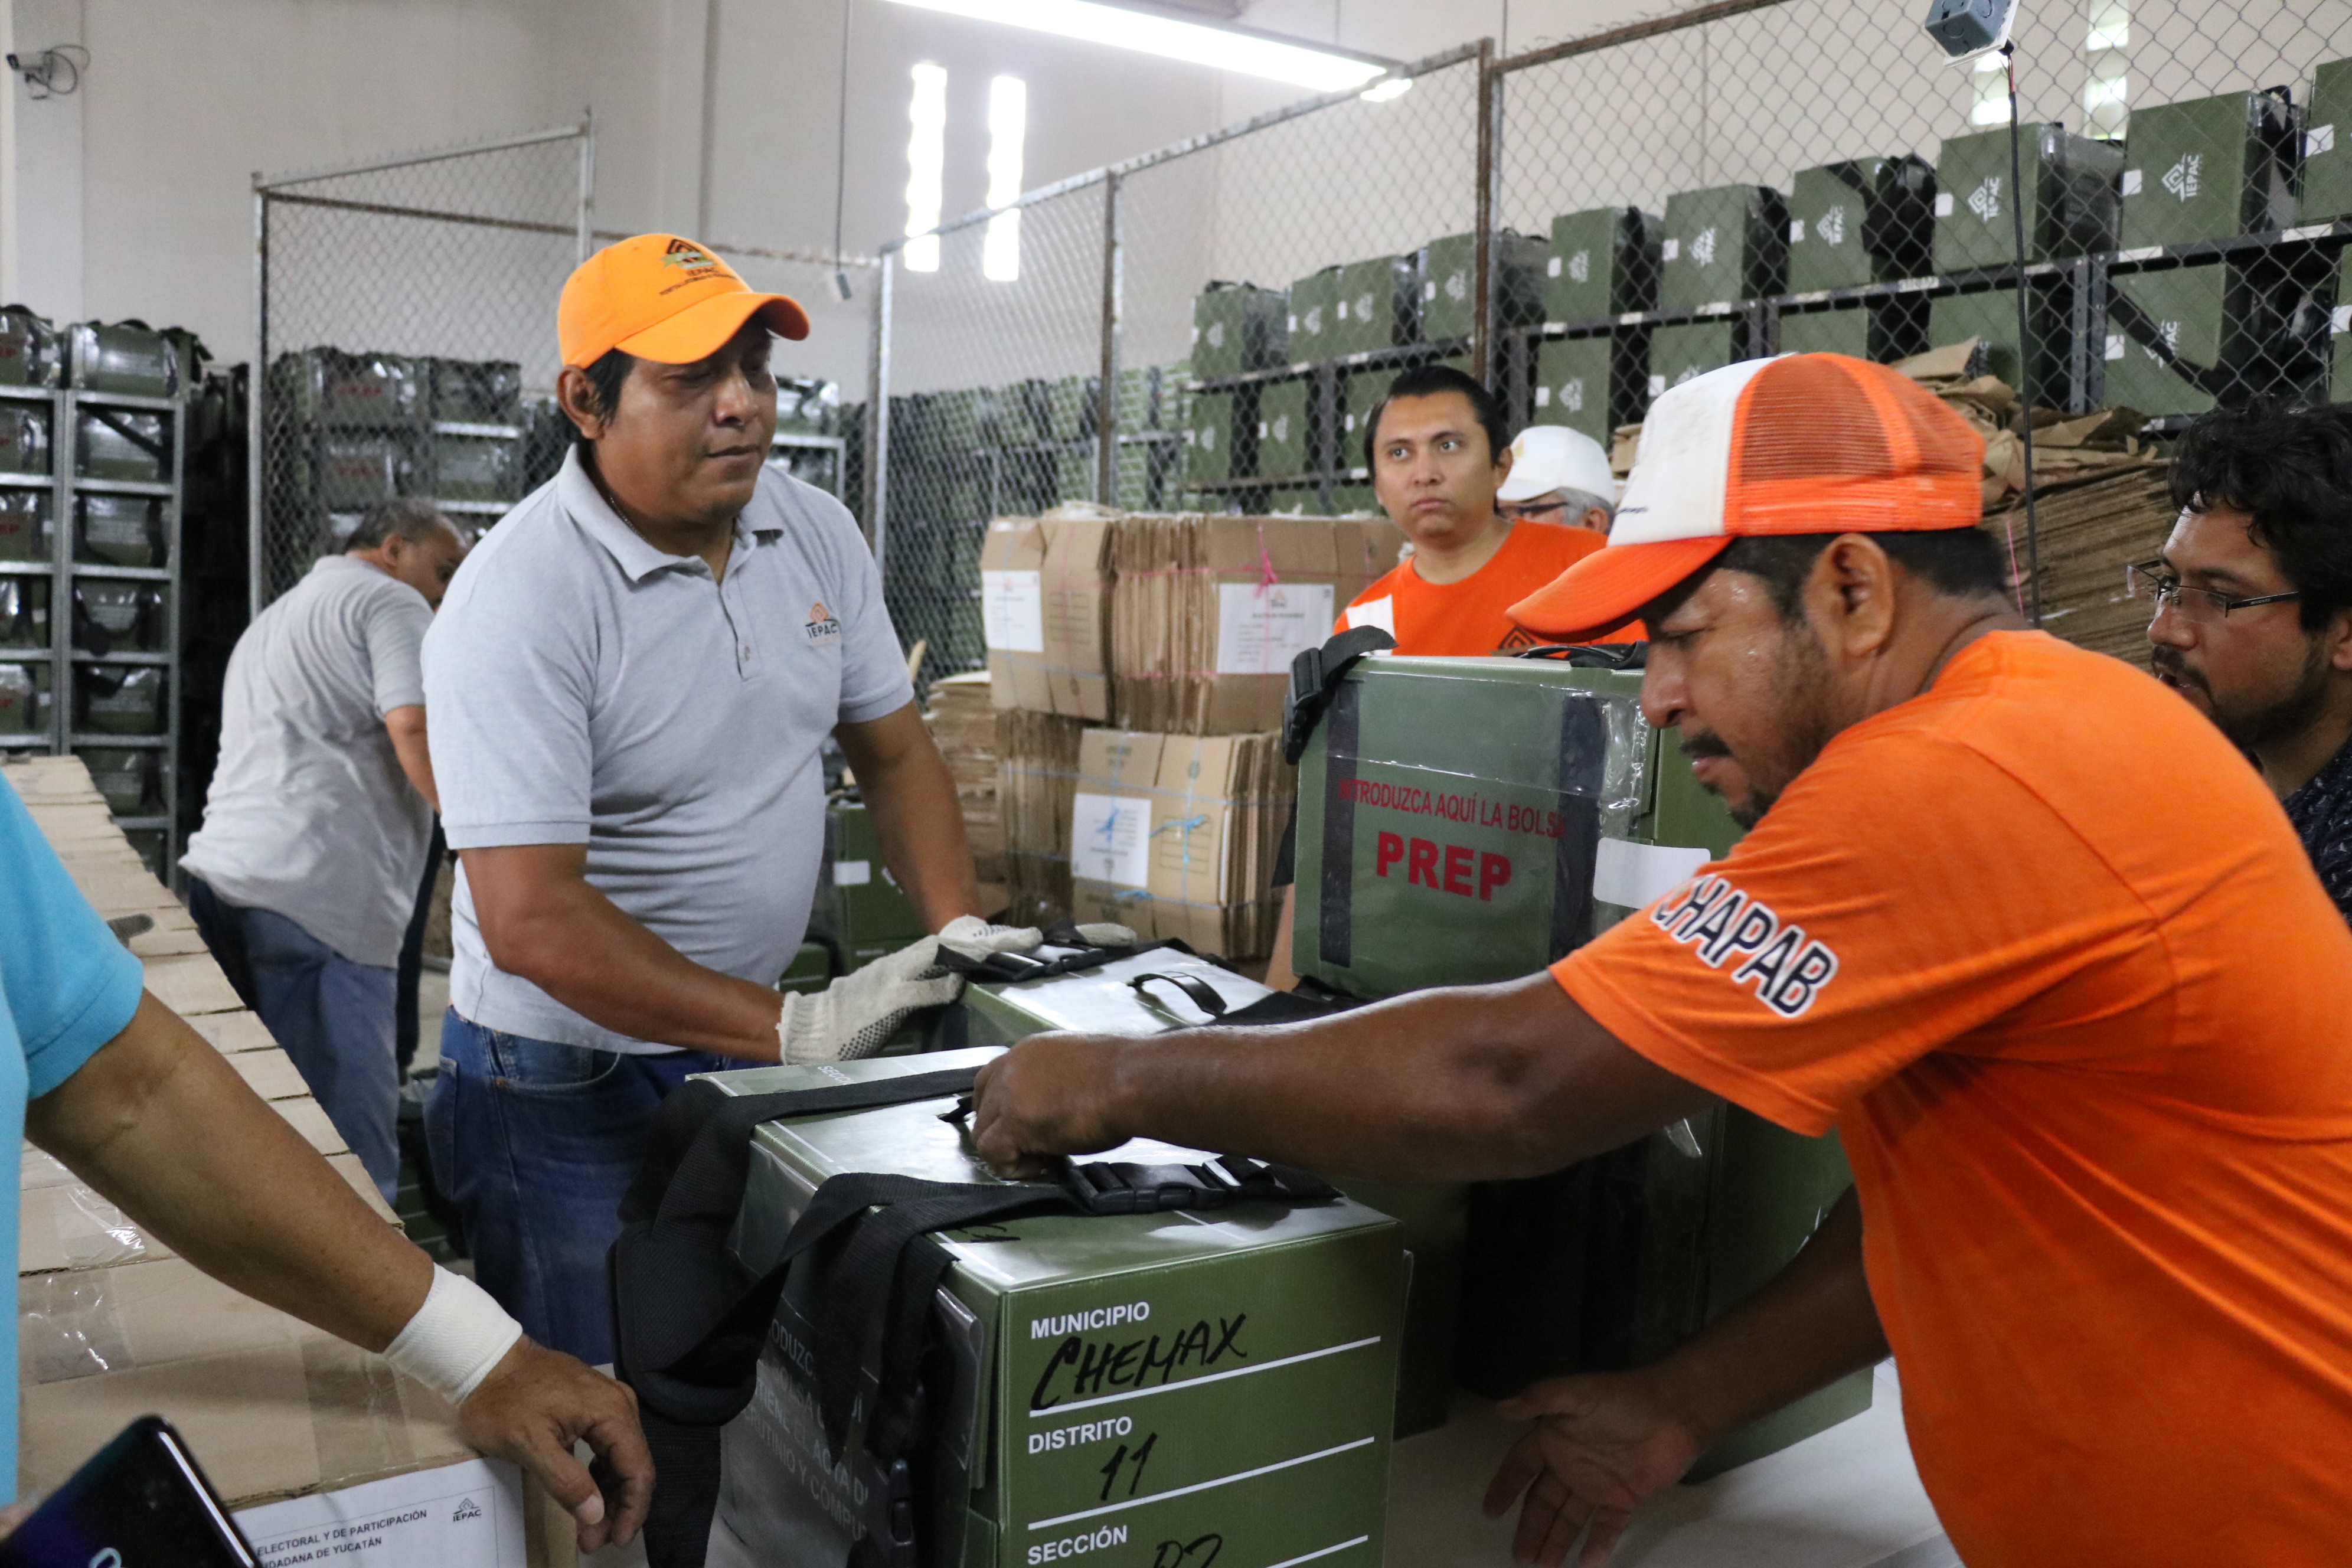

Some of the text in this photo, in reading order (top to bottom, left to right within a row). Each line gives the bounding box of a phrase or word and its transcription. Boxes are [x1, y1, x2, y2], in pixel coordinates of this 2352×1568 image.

[2185, 155, 2200, 197] IEPAC
[806, 623, 837, 638] IEPAC
[1338, 778, 1432, 816] INTRODUZCA
[1435, 792, 1477, 823] AQUÍ
[1481, 800, 1504, 828] LA
[1377, 830, 1512, 901] PREP
[1650, 874, 1838, 1018] CHAPAB
[1031, 1301, 1150, 1339] MUNICIPIO
[1030, 1313, 1247, 1410] CHEMAX
[1028, 1416, 1132, 1454] DISTRITO
[1100, 1432, 1157, 1501] 11
[258, 1510, 427, 1556] ELECTORAL Y DE PARTICIPACIÓN
[452, 1509, 482, 1523] IEPAC
[316, 1547, 331, 1559] DE
[333, 1536, 383, 1554] YUCATÁN
[1027, 1524, 1128, 1566] SECCIÓN
